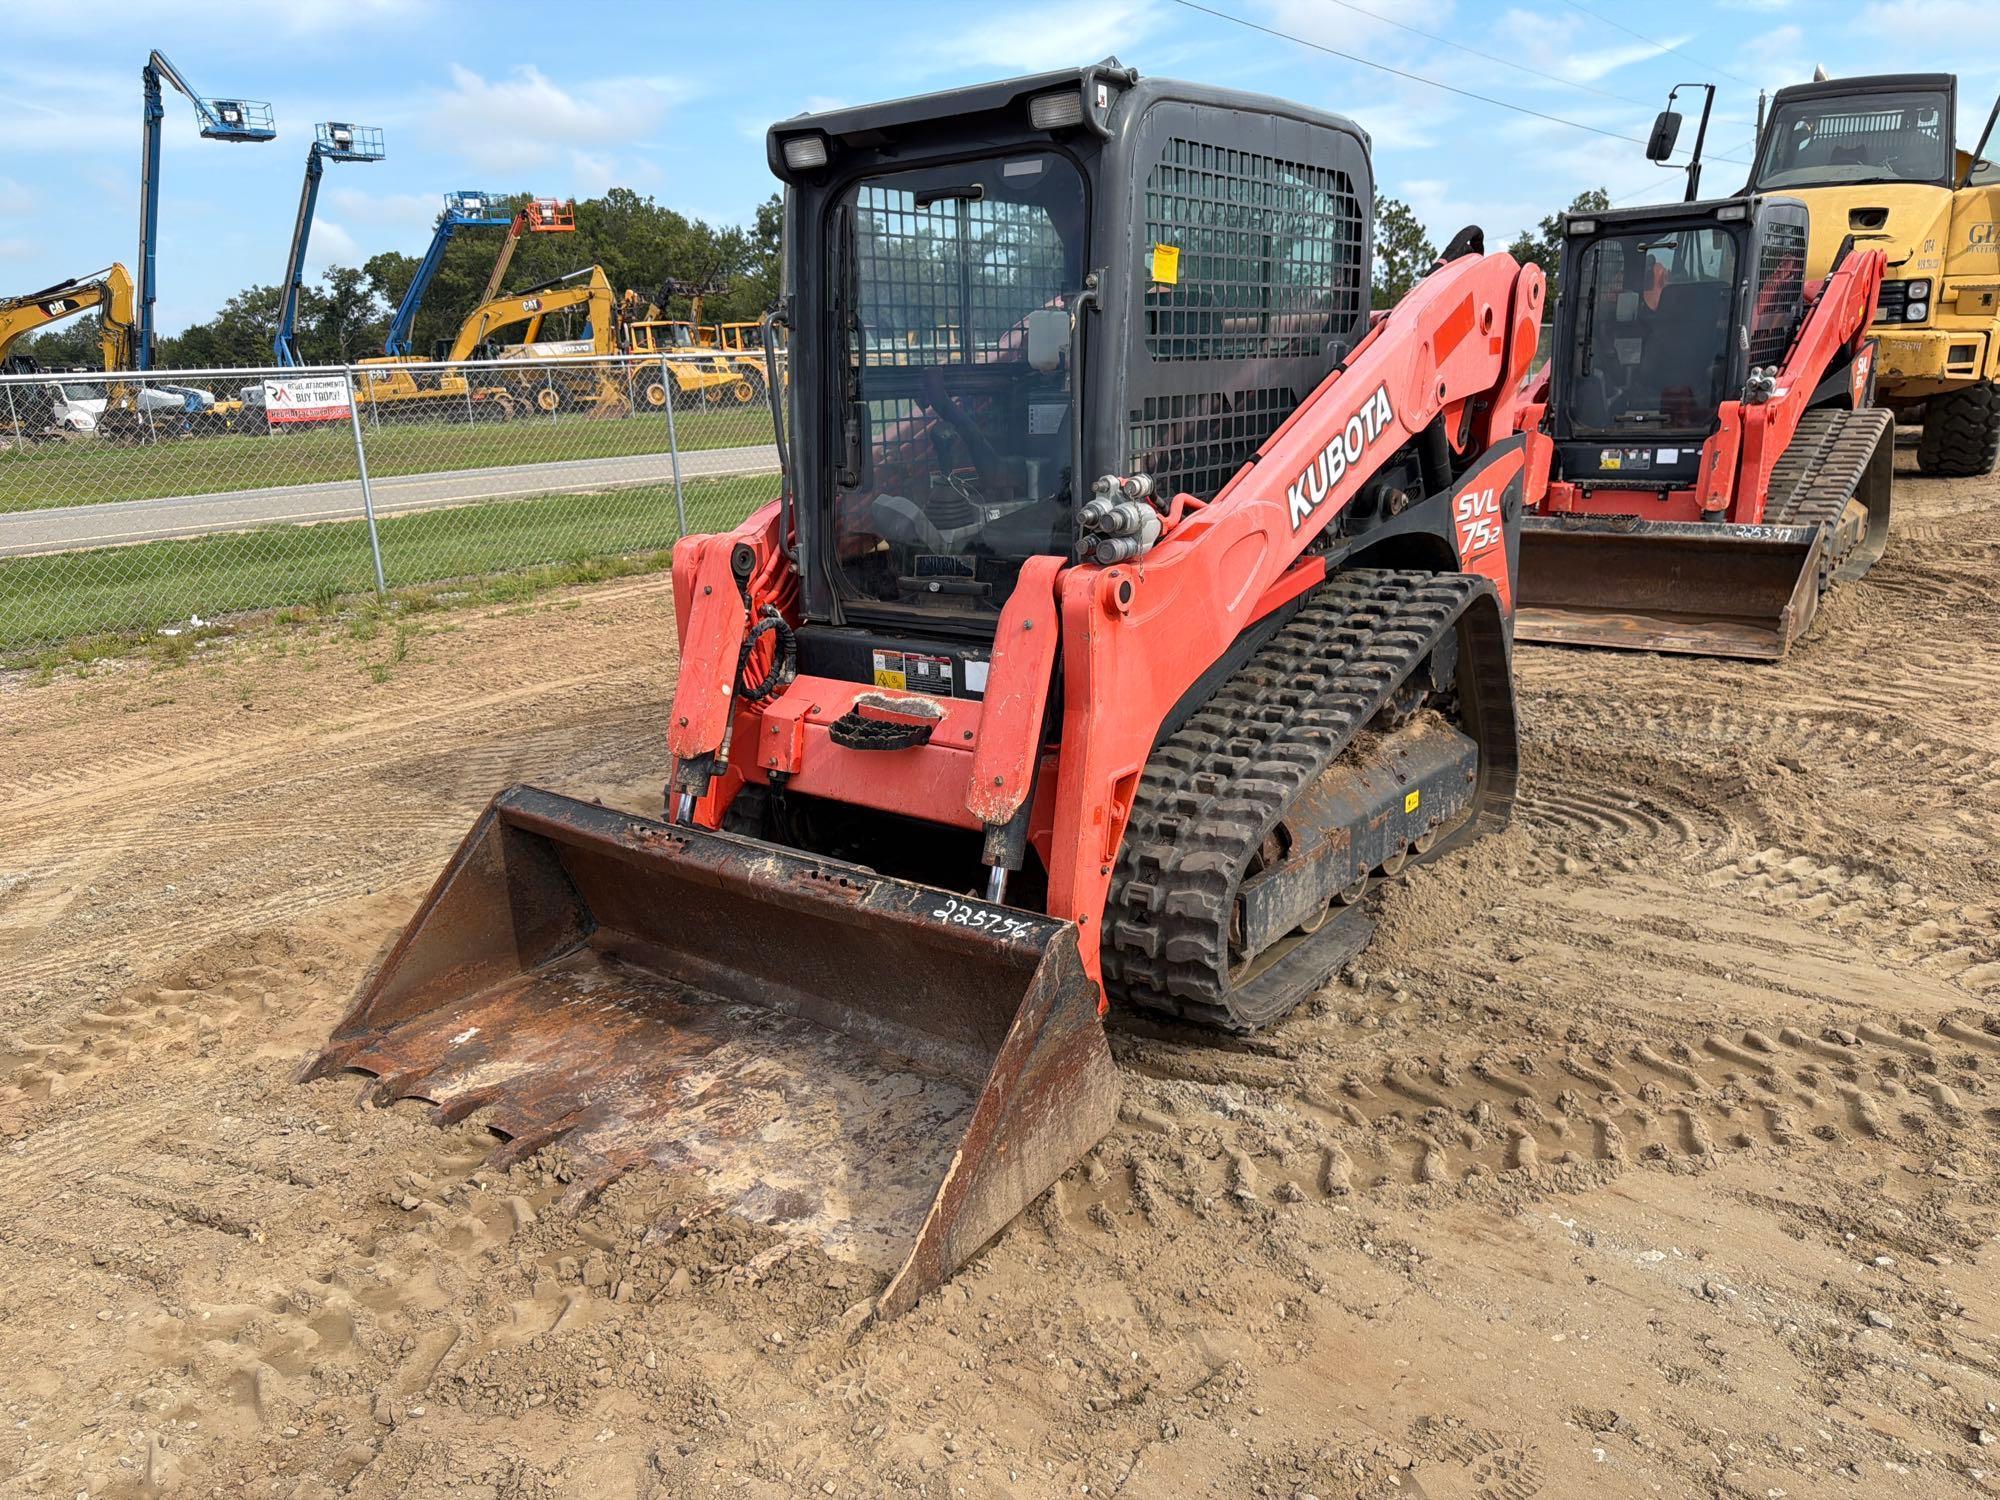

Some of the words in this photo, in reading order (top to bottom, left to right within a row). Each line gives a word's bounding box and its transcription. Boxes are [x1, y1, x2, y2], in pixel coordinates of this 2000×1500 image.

[48, 300, 66, 316] CAT
[522, 299, 538, 312] CAT
[559, 344, 589, 353] VOLVO
[305, 380, 345, 390] ATTACHMENTS
[295, 392, 312, 403] BUY
[313, 390, 341, 402] TODAY!
[1287, 384, 1394, 530] KUBOTA
[1456, 487, 1499, 523] SVL
[932, 896, 1033, 938] 225756
